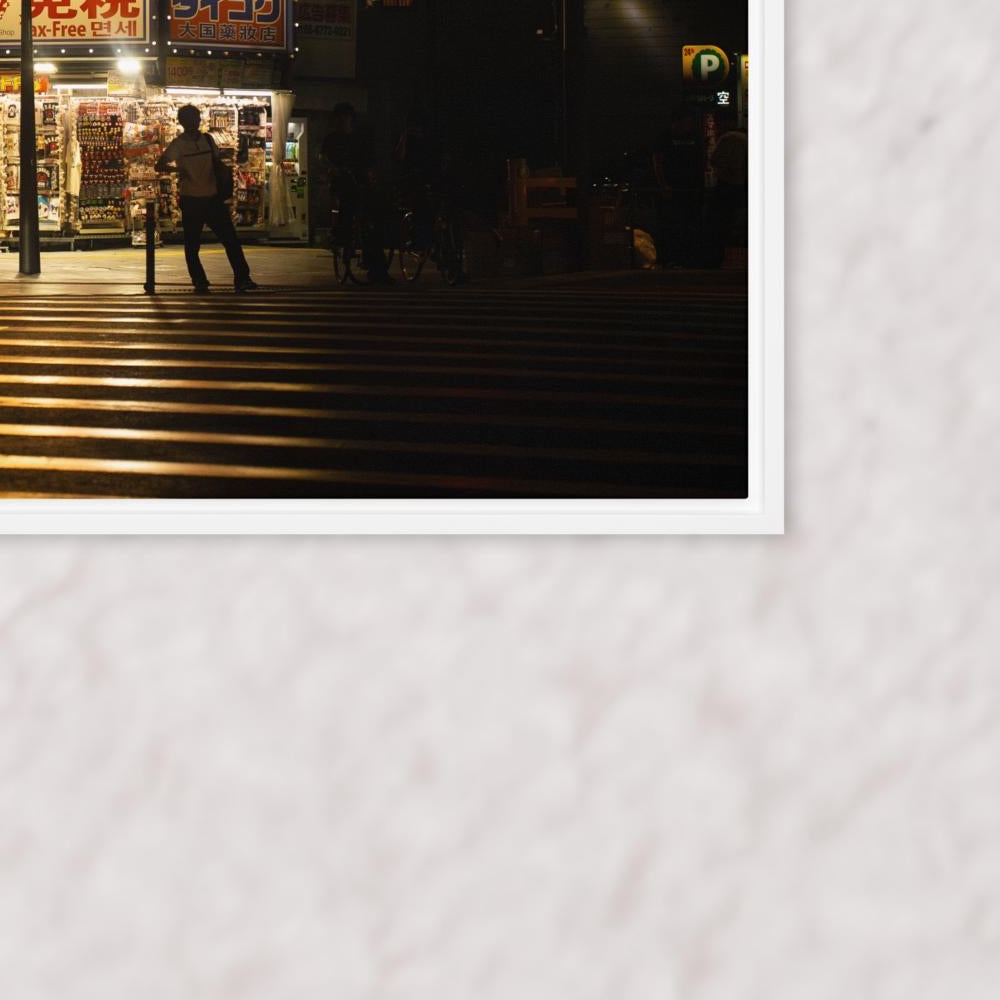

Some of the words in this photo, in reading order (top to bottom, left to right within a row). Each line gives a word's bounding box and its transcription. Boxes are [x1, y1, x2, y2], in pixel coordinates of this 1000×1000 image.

[31, 21, 87, 37] ax-Free
[700, 54, 720, 80] P
[717, 91, 730, 105] 空
